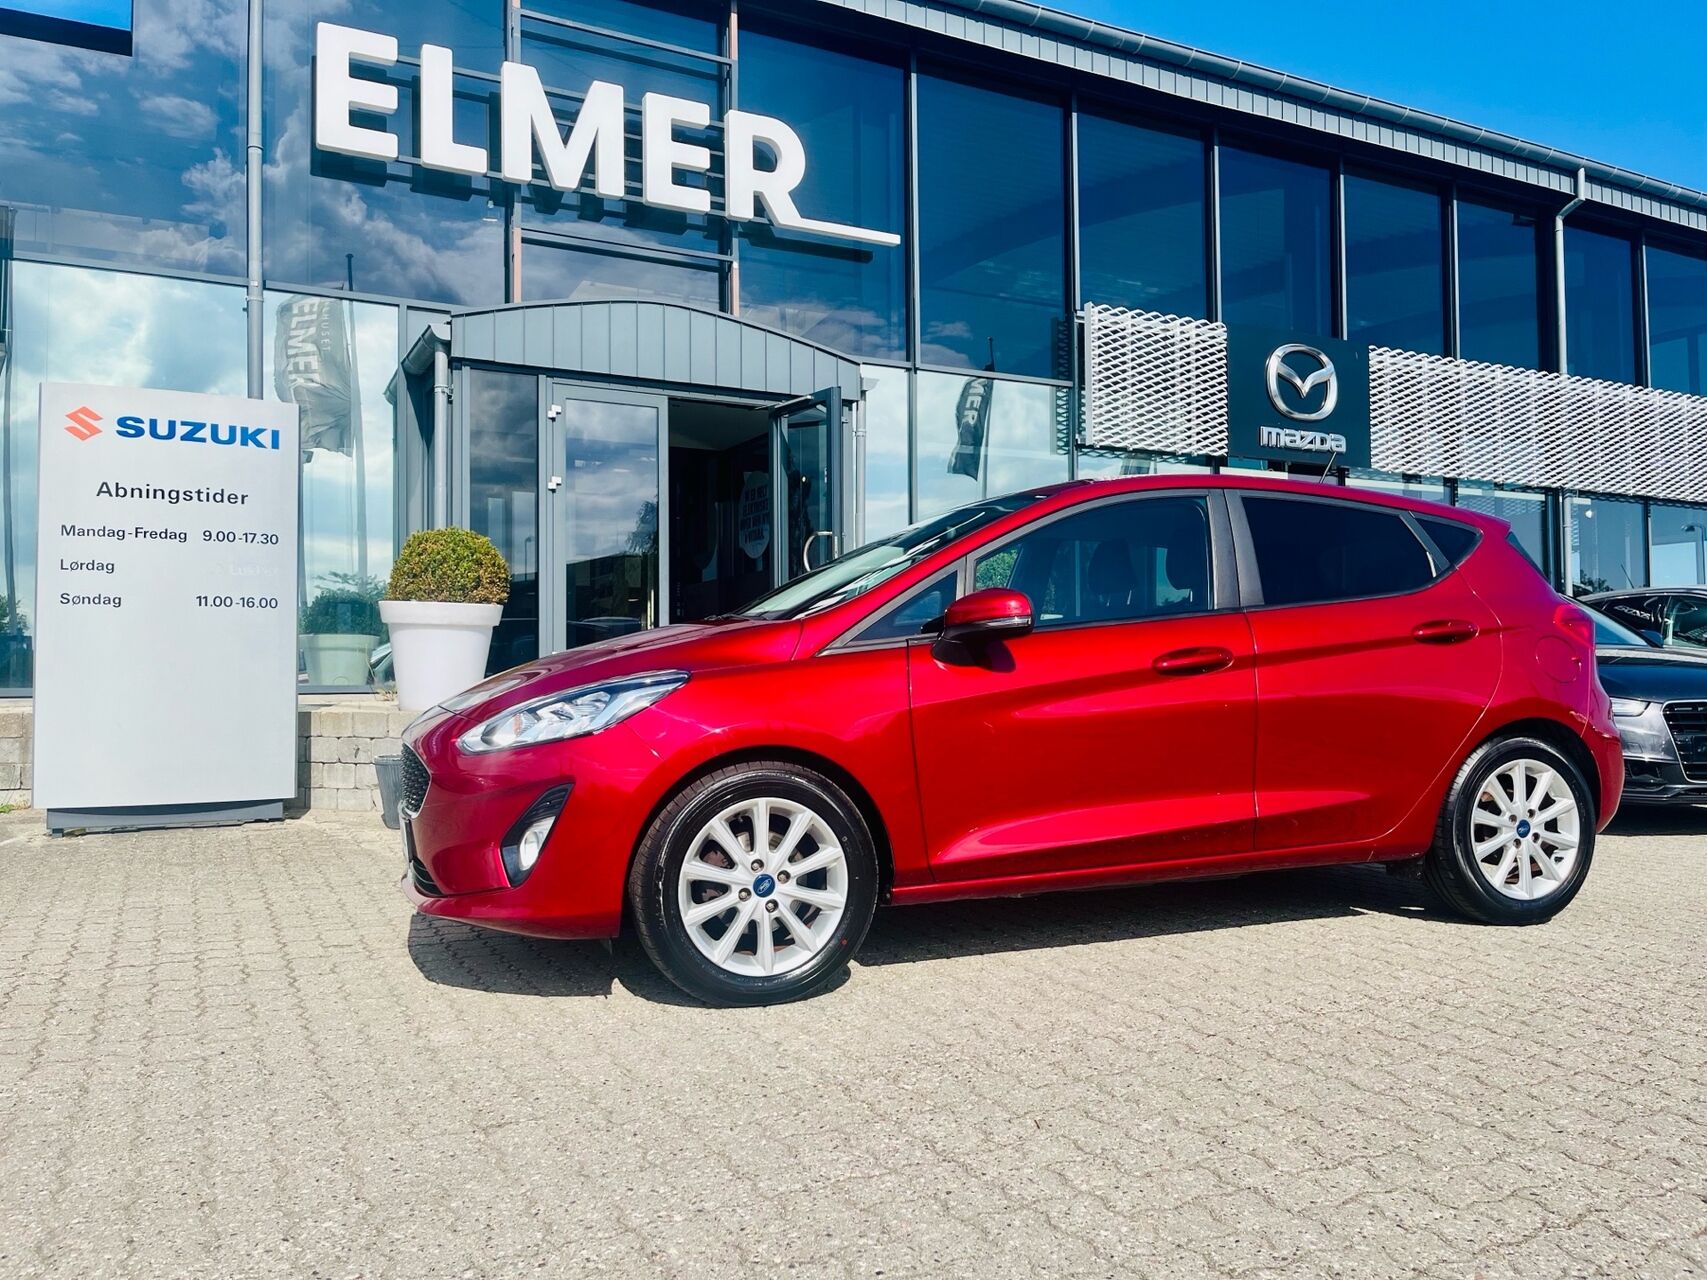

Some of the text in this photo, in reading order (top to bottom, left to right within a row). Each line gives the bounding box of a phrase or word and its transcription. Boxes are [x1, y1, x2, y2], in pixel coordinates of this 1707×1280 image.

[316, 21, 901, 246] ELMER
[116, 416, 280, 450] SUZUKI
[60, 559, 115, 574] Lørdag
[60, 593, 122, 608] Søndag
